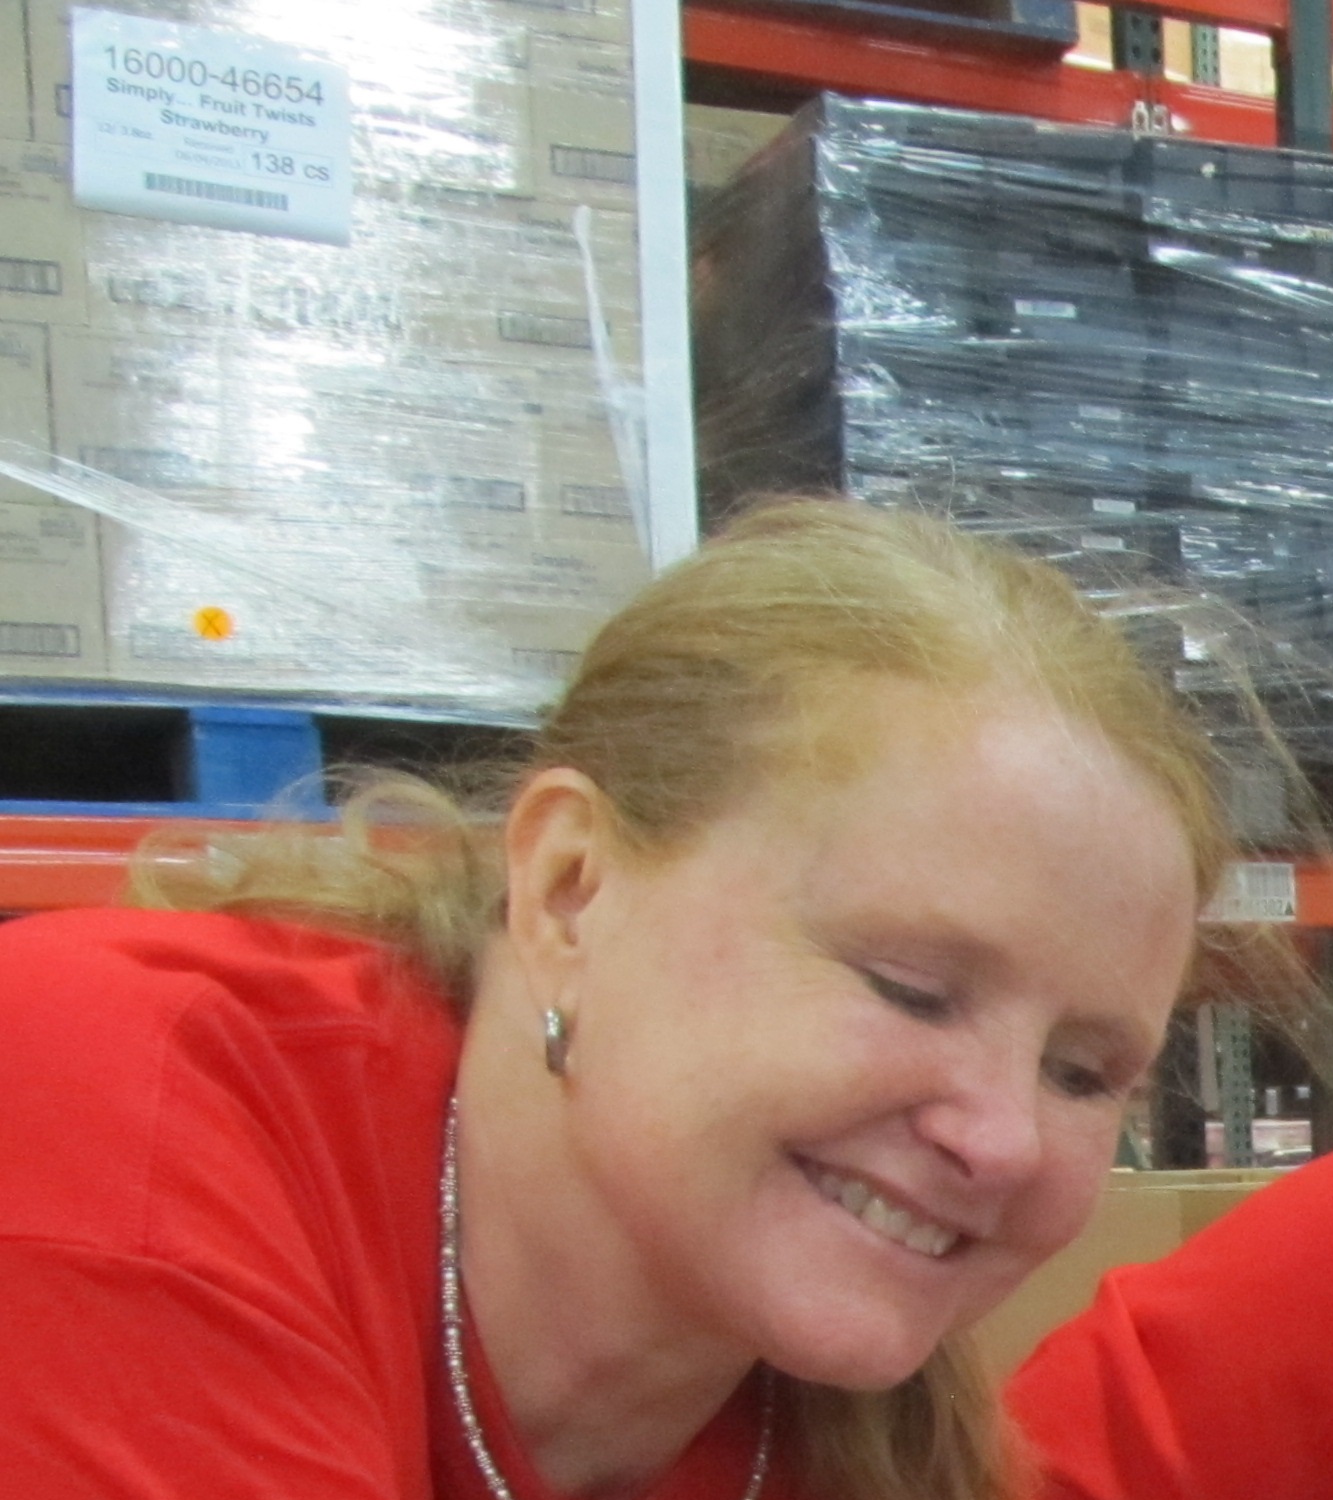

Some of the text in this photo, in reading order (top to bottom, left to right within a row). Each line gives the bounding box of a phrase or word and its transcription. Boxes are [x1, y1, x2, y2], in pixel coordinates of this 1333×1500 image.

[104, 44, 324, 106] 16000-46654
[160, 109, 269, 143] Strawberry
[199, 94, 246, 117] Fruit
[252, 103, 316, 127] Twists
[250, 152, 296, 176] 138
